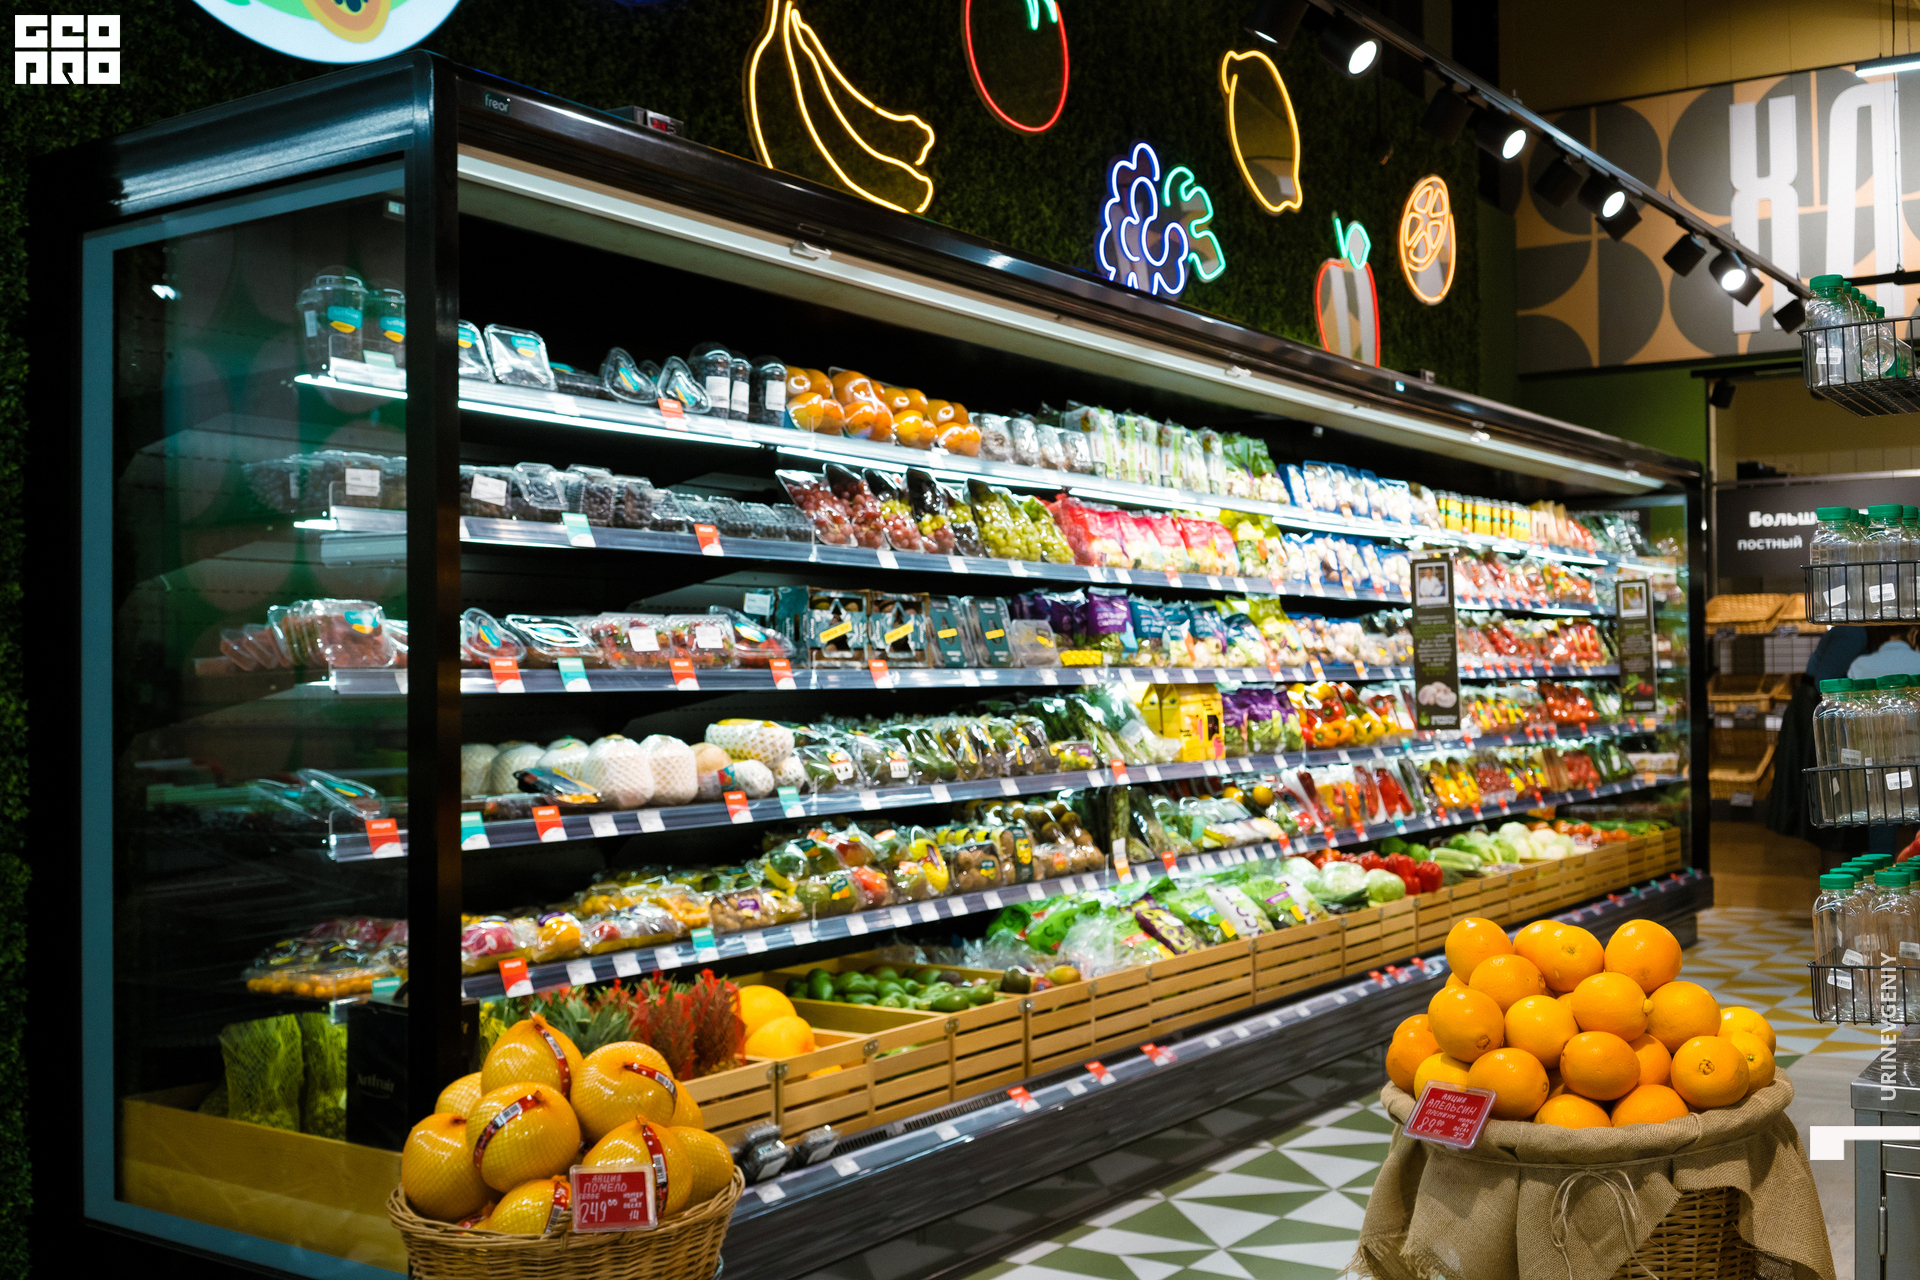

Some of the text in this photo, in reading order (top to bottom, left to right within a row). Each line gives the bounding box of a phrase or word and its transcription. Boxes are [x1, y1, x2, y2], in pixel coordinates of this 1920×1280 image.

[1749, 511, 1818, 528] Больш
[1737, 535, 1803, 551] постный
[1441, 1093, 1468, 1104] АКЦИЯ
[1426, 1098, 1478, 1116] АПЕЛЬСИН
[1425, 1109, 1457, 1120] ПРЕМИУМ
[592, 1174, 622, 1183] АКЦИЯ
[583, 1182, 628, 1193] ПОМЕЛО
[580, 1200, 607, 1224] 249
